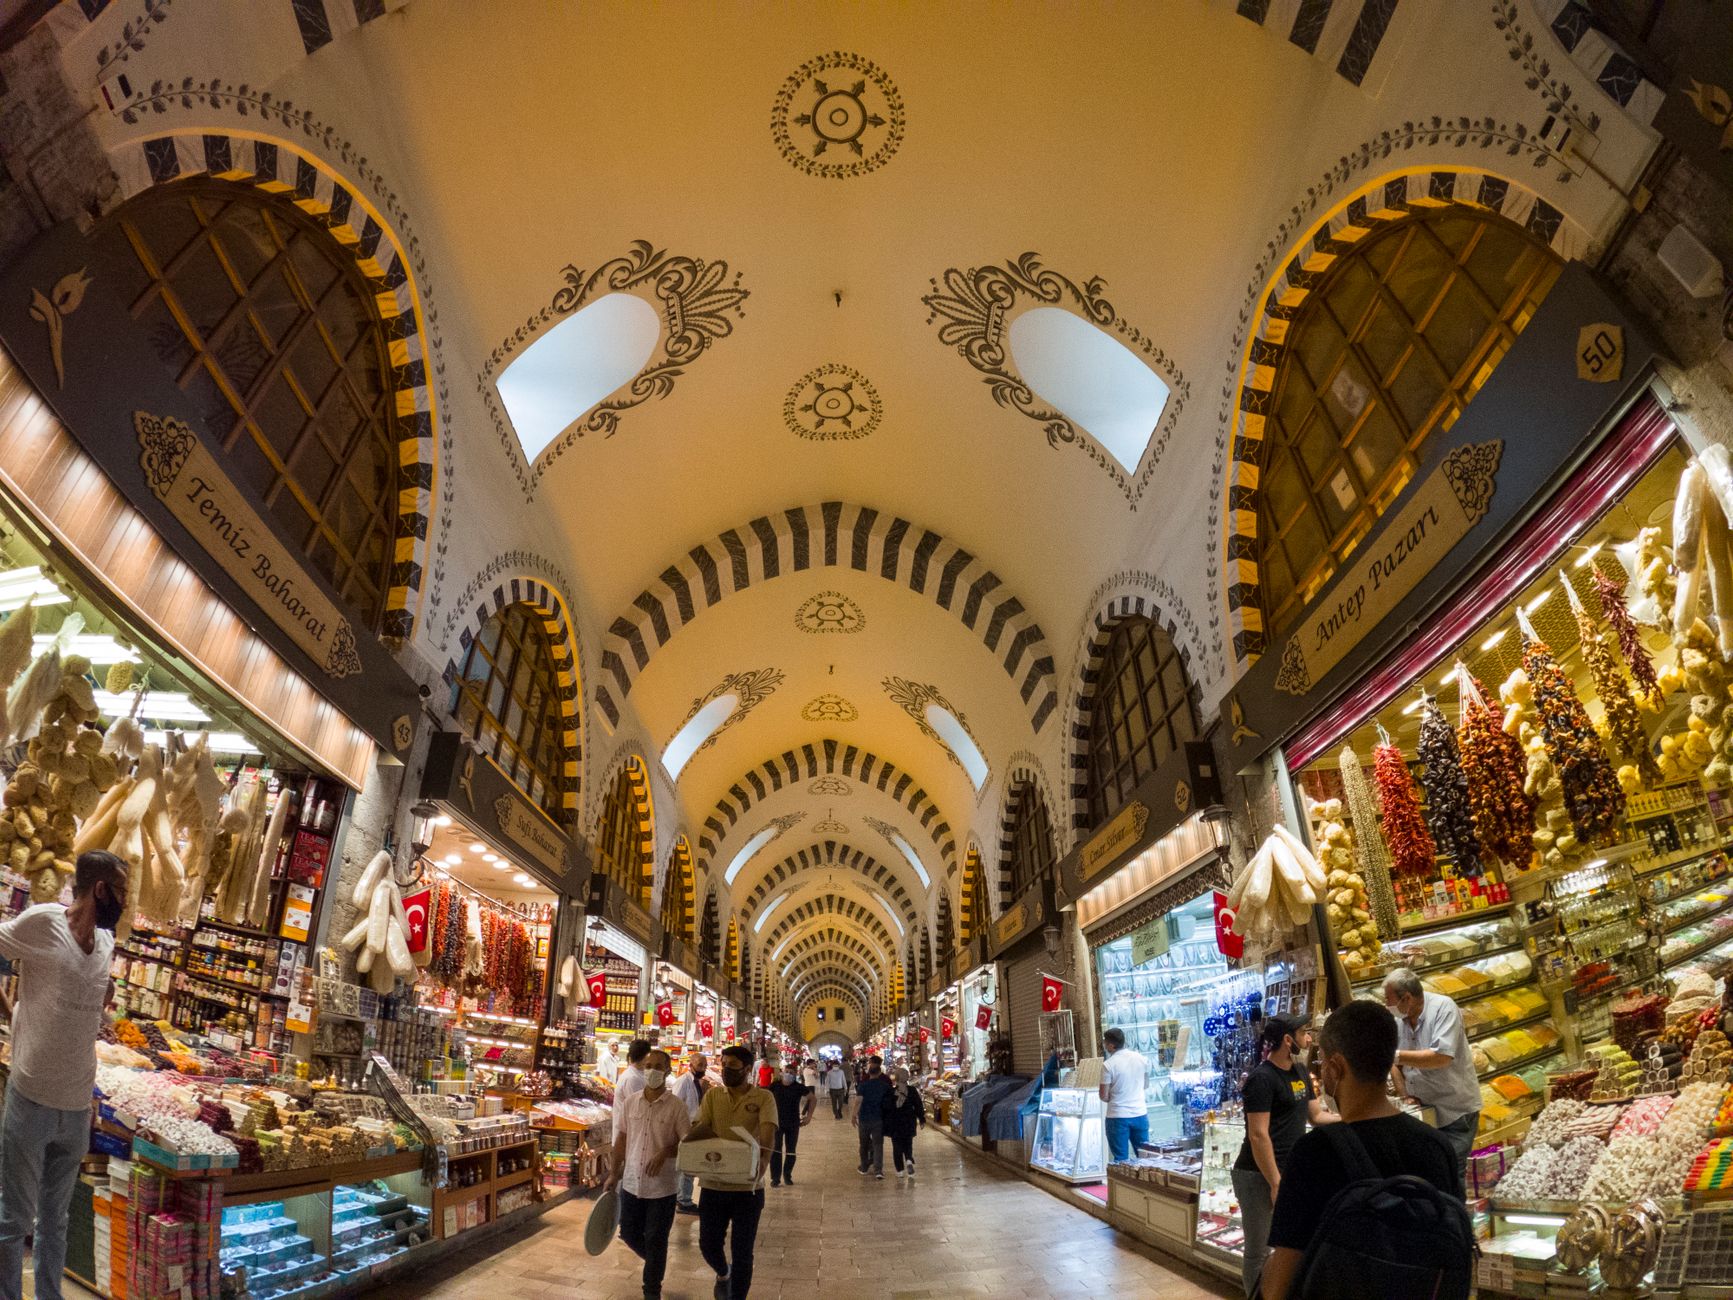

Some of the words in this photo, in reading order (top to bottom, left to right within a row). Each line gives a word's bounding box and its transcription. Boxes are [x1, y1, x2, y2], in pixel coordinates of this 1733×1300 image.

[1583, 332, 1616, 373] 50
[186, 477, 250, 558] Temiz
[252, 554, 326, 641] Baharat
[1316, 585, 1366, 652] Antep
[1368, 506, 1439, 591] Pazarı
[398, 723, 410, 743] 43
[1176, 787, 1187, 805] 52
[532, 828, 557, 857] Baharat
